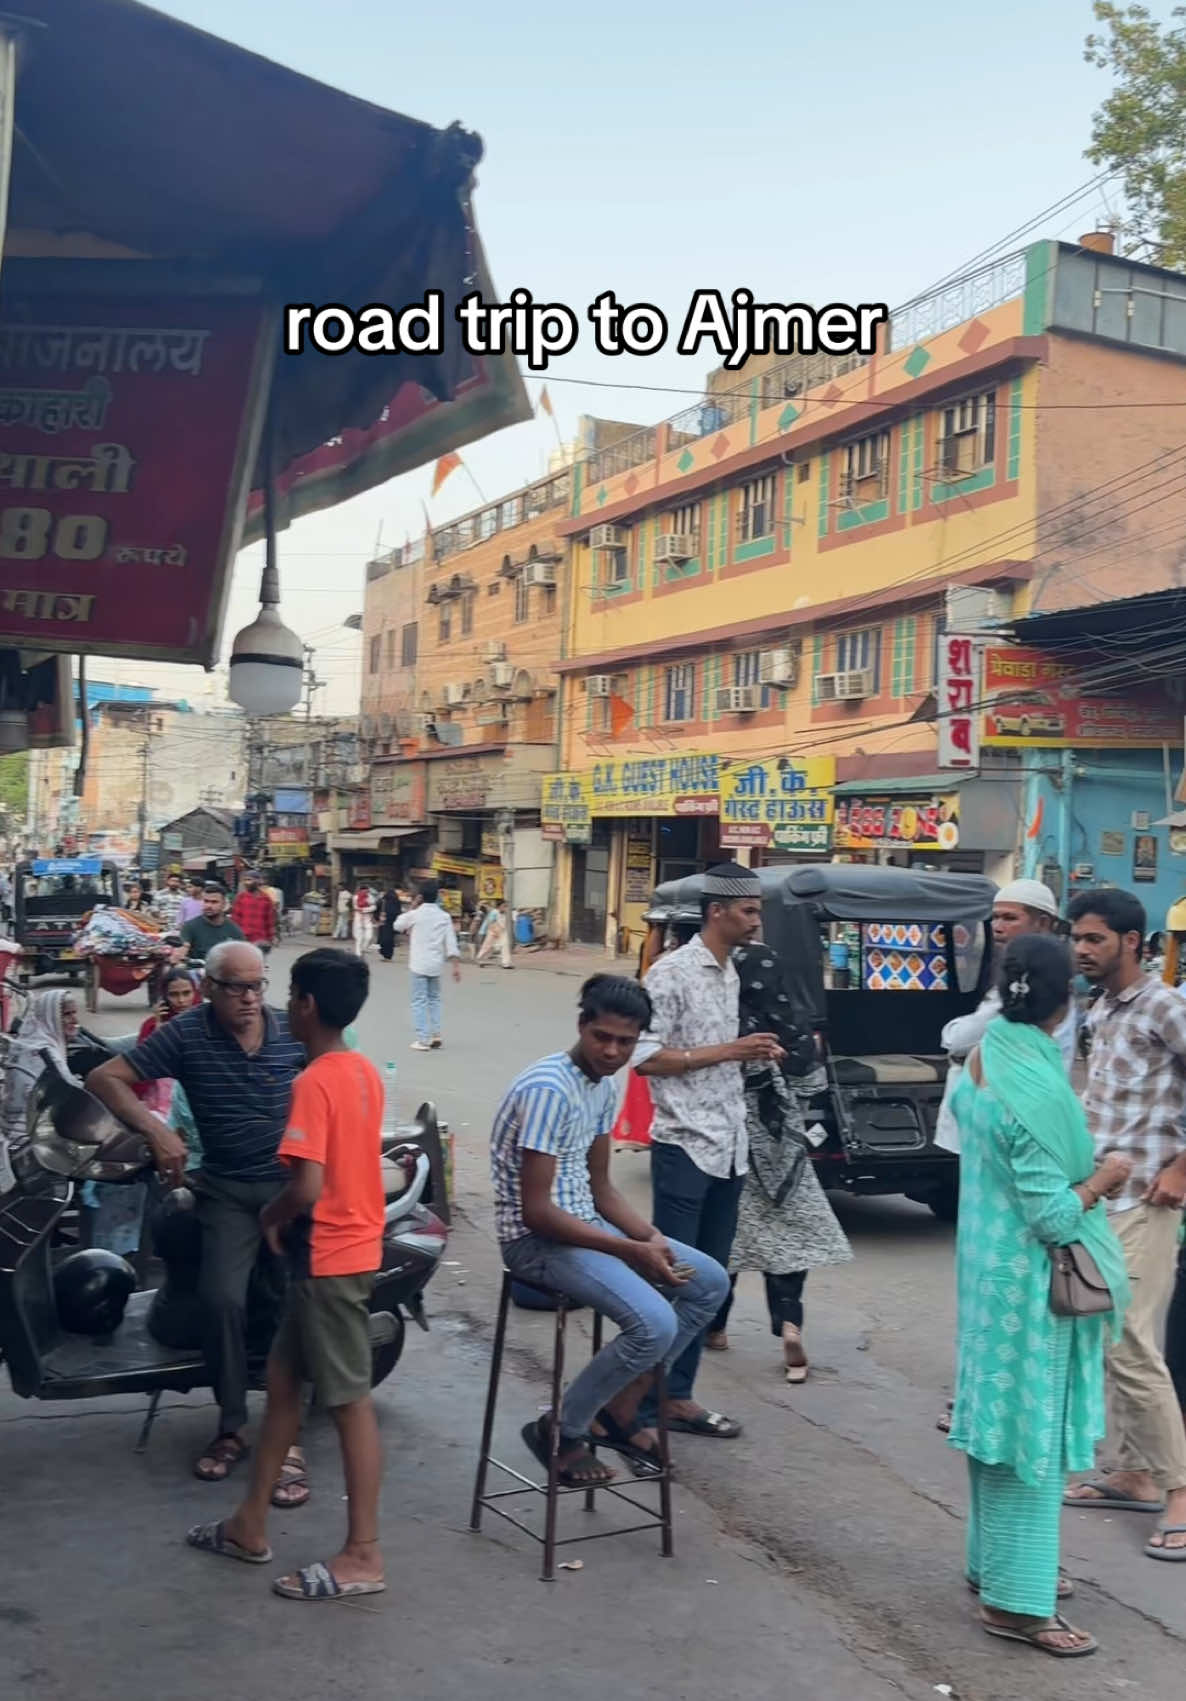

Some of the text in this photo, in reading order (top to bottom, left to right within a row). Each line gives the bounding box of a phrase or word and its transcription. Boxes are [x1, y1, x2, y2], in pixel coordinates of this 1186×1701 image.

[0, 507, 108, 560] 80
[623, 759, 664, 794] GUEST
[669, 754, 720, 794] HOUSE
